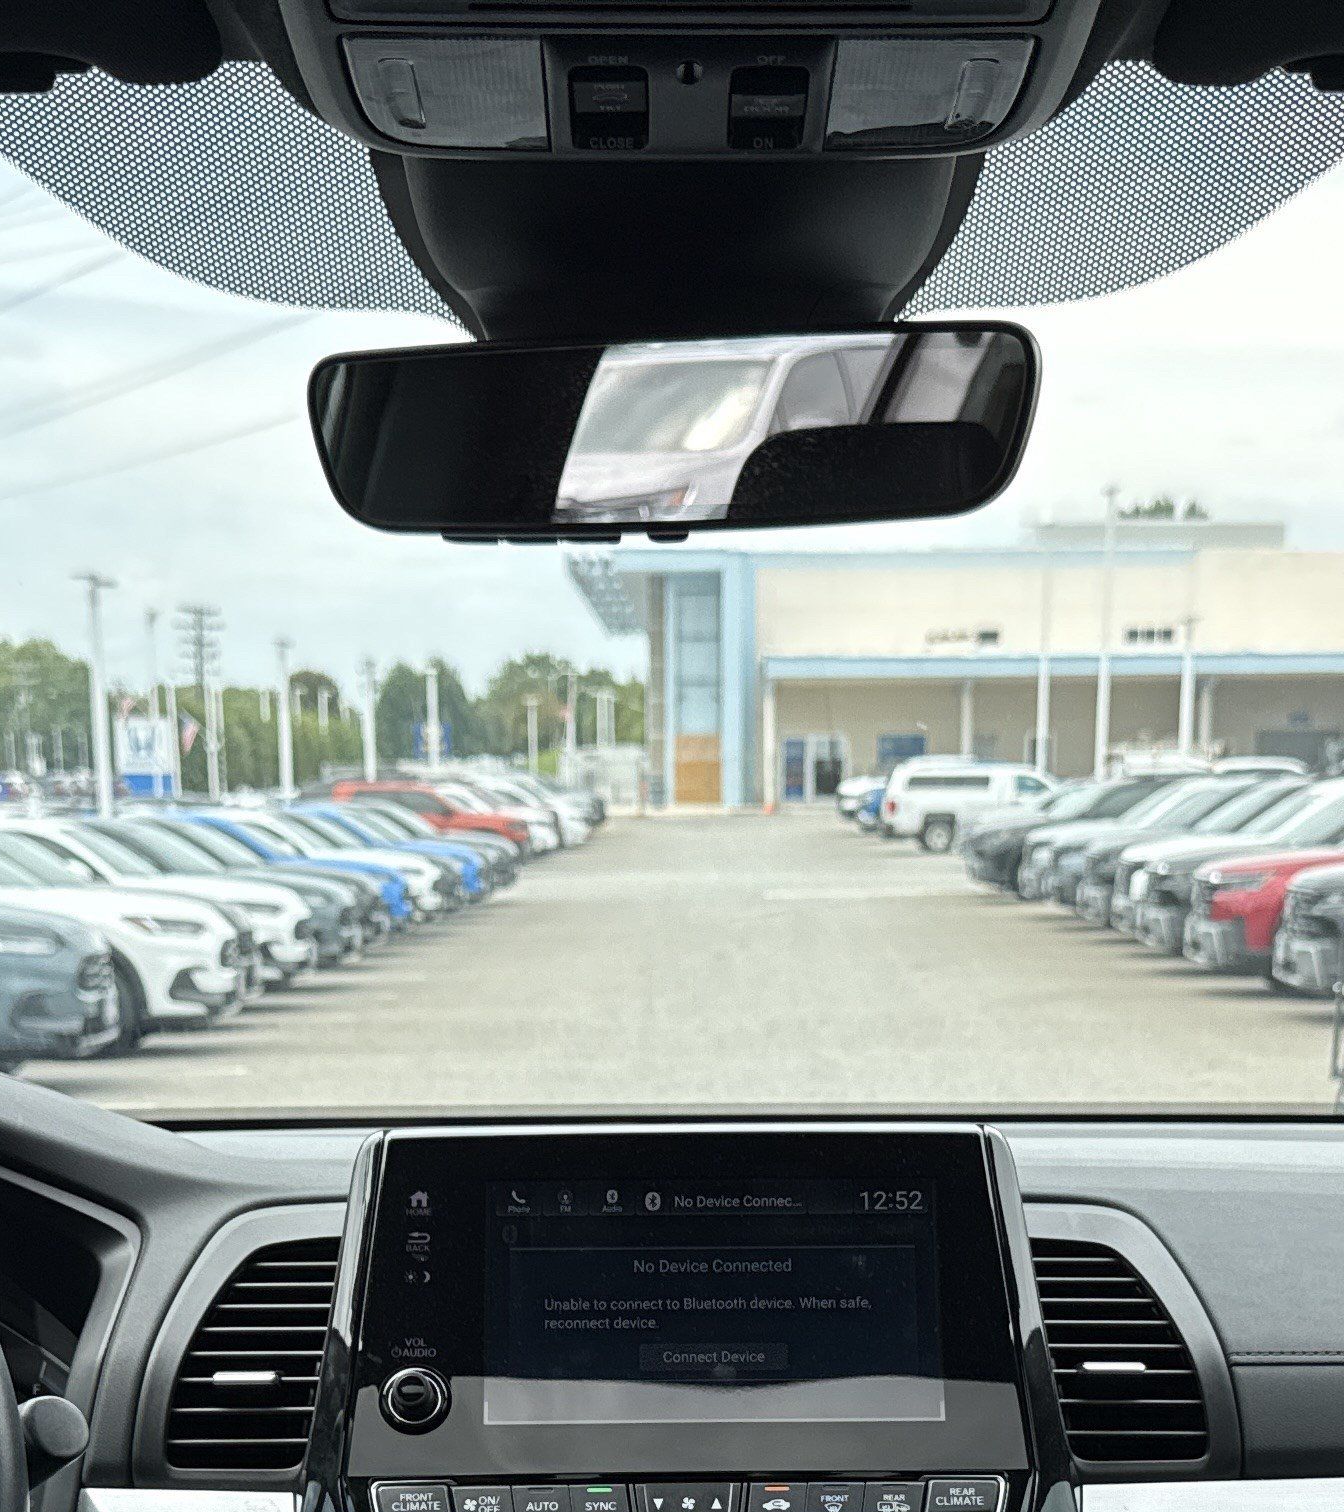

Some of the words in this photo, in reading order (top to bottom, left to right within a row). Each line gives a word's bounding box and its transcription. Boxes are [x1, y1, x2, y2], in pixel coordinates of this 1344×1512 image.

[588, 55, 629, 65] OPEN
[757, 55, 786, 65] OFF
[589, 136, 634, 149] CLOSE
[753, 136, 774, 149] ON
[673, 1195, 693, 1208] No
[696, 1194, 740, 1208] Device
[859, 1190, 924, 1211] 12:52
[406, 1208, 431, 1216] HOME
[507, 1204, 531, 1214] Phone
[601, 1204, 624, 1213] Audio
[406, 1243, 431, 1252] BACK
[633, 1260, 655, 1273] No
[659, 1259, 708, 1273] Device
[712, 1258, 793, 1273] Connected
[544, 1298, 590, 1311] Unable
[593, 1300, 607, 1311] to
[610, 1299, 663, 1311] connect
[666, 1299, 680, 1311] to
[683, 1297, 747, 1310] Bluetooth
[749, 1296, 795, 1310] device.
[799, 1296, 836, 1309] When
[839, 1296, 872, 1311] safe,
[544, 1317, 610, 1330] reconnect
[613, 1316, 659, 1330] device.
[405, 1338, 427, 1348] VOL
[403, 1348, 437, 1358] AUDIO
[663, 1350, 718, 1364] Connect
[721, 1350, 766, 1364] Device
[949, 1487, 976, 1496] REAR
[399, 1493, 433, 1502] FRONT
[478, 1496, 500, 1506] ON/
[820, 1494, 849, 1502] FRONT
[883, 1494, 906, 1502] REAR
[935, 1496, 985, 1507] CLIMATE
[391, 1501, 441, 1512] CLIMATE
[525, 1501, 559, 1512] AUTO
[585, 1501, 617, 1512] SYNC
